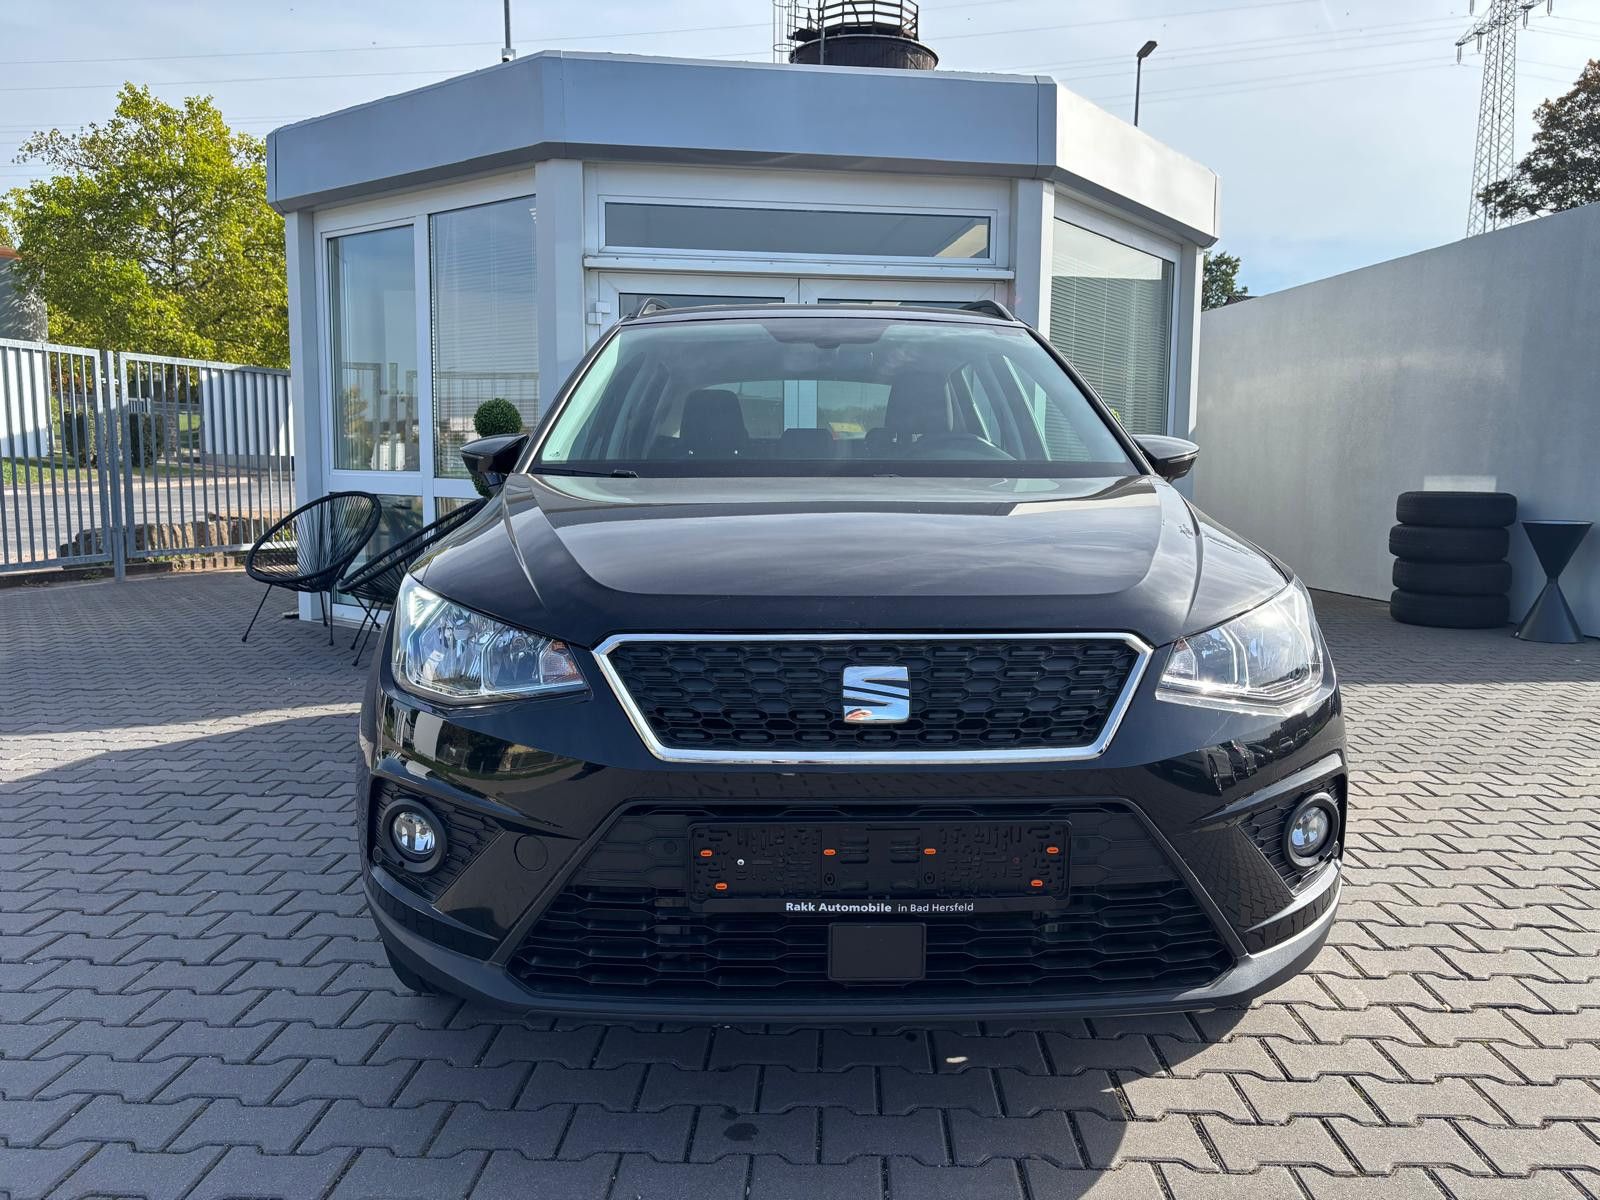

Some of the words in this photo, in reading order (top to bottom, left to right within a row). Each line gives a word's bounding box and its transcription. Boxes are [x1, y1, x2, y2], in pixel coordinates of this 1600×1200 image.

[785, 902, 816, 912] Rakk
[818, 902, 892, 912] Automobile
[898, 903, 908, 912] in
[910, 903, 929, 912] Bad
[932, 902, 974, 912] Hersfeld
